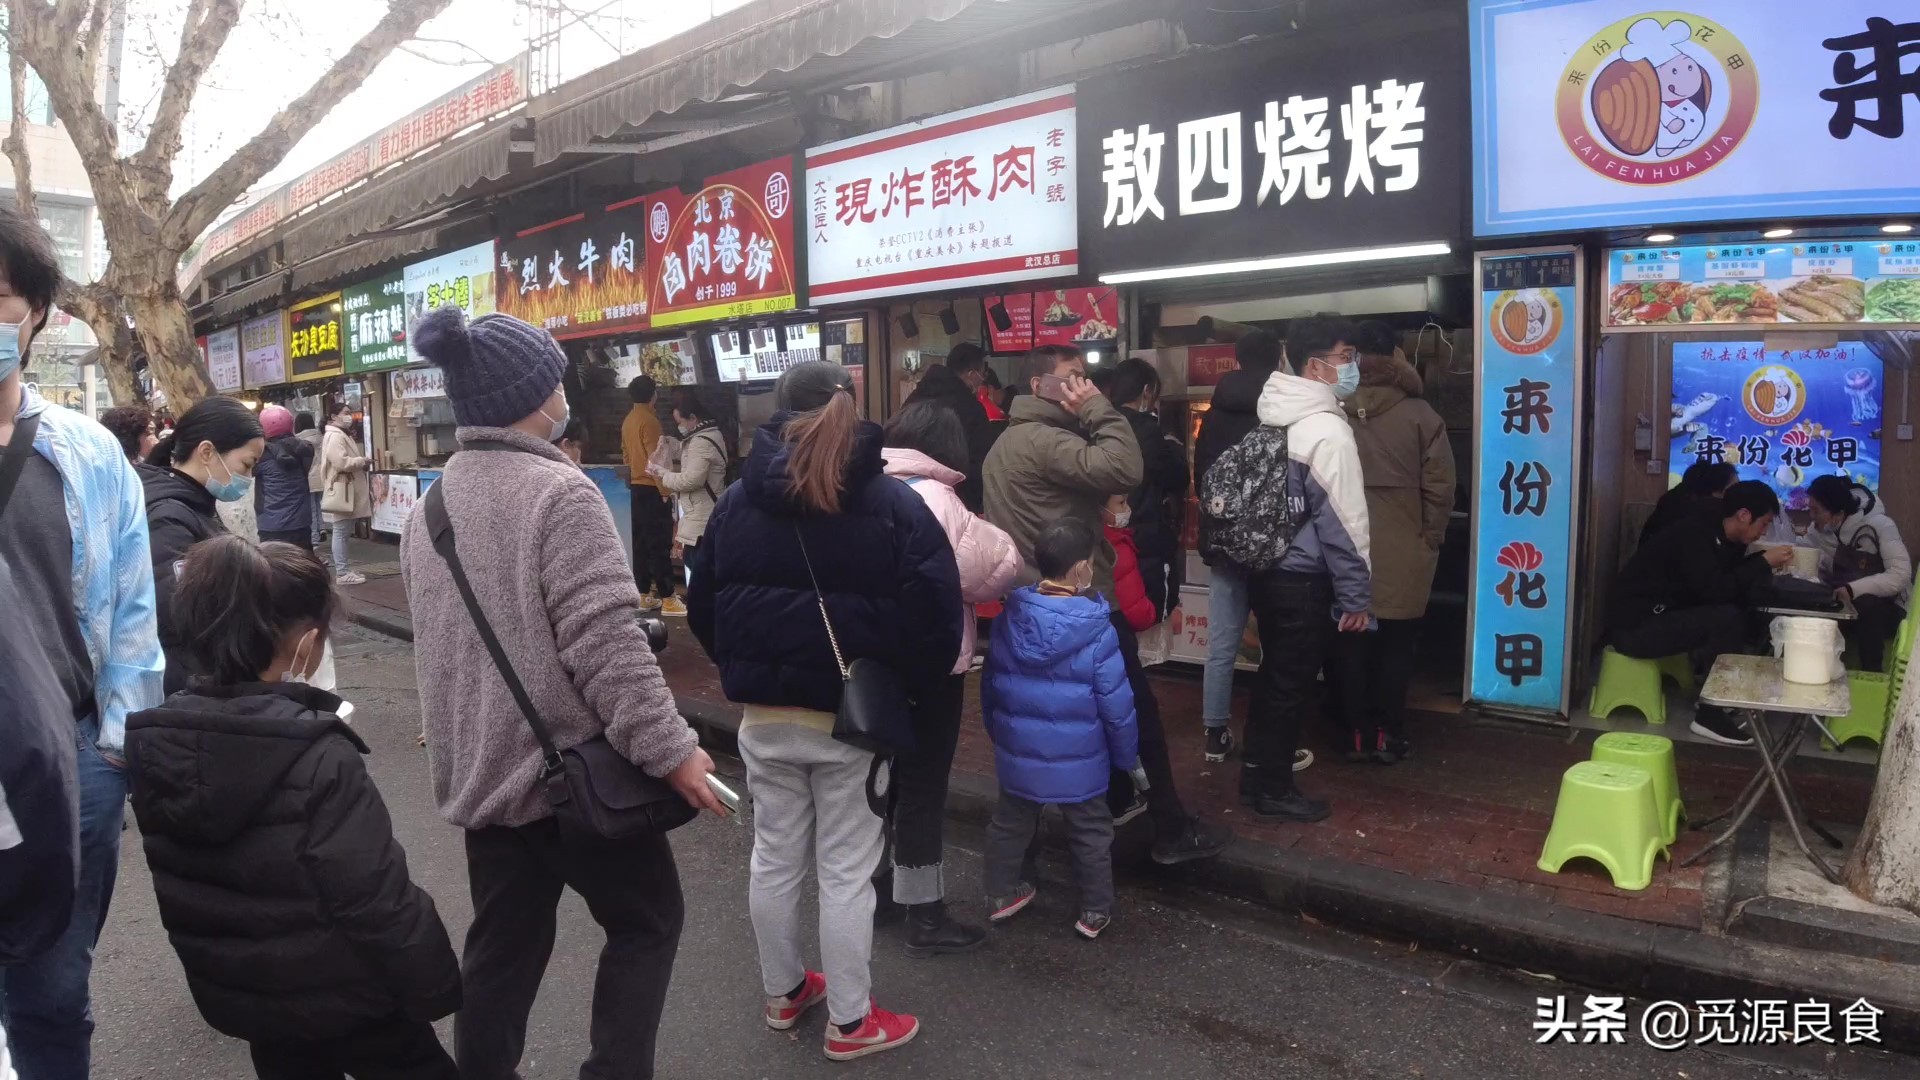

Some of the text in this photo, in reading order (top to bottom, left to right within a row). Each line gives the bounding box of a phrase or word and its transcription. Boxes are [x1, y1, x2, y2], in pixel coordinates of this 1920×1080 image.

[1567, 24, 1745, 86] 来份花甲
[1046, 128, 1066, 203] 老字號
[1102, 78, 1426, 229] 敖四烧烤
[1573, 134, 1600, 163] LAI
[1704, 133, 1734, 162] JIA
[767, 175, 787, 215] 哥
[834, 145, 1036, 226] 現炸酥肉
[694, 189, 735, 226] 北京
[520, 232, 634, 295] 烈火牛肉
[662, 223, 773, 304] 卤肉卷饼
[1024, 254, 1061, 268] 武汉总店
[727, 302, 753, 315] 水塔店
[291, 320, 339, 358] 长沙臭豆腐
[1700, 347, 1767, 361] 抗击疫情
[1694, 429, 1858, 467] 来份花甲
[1494, 377, 1554, 687] 来份花甲
